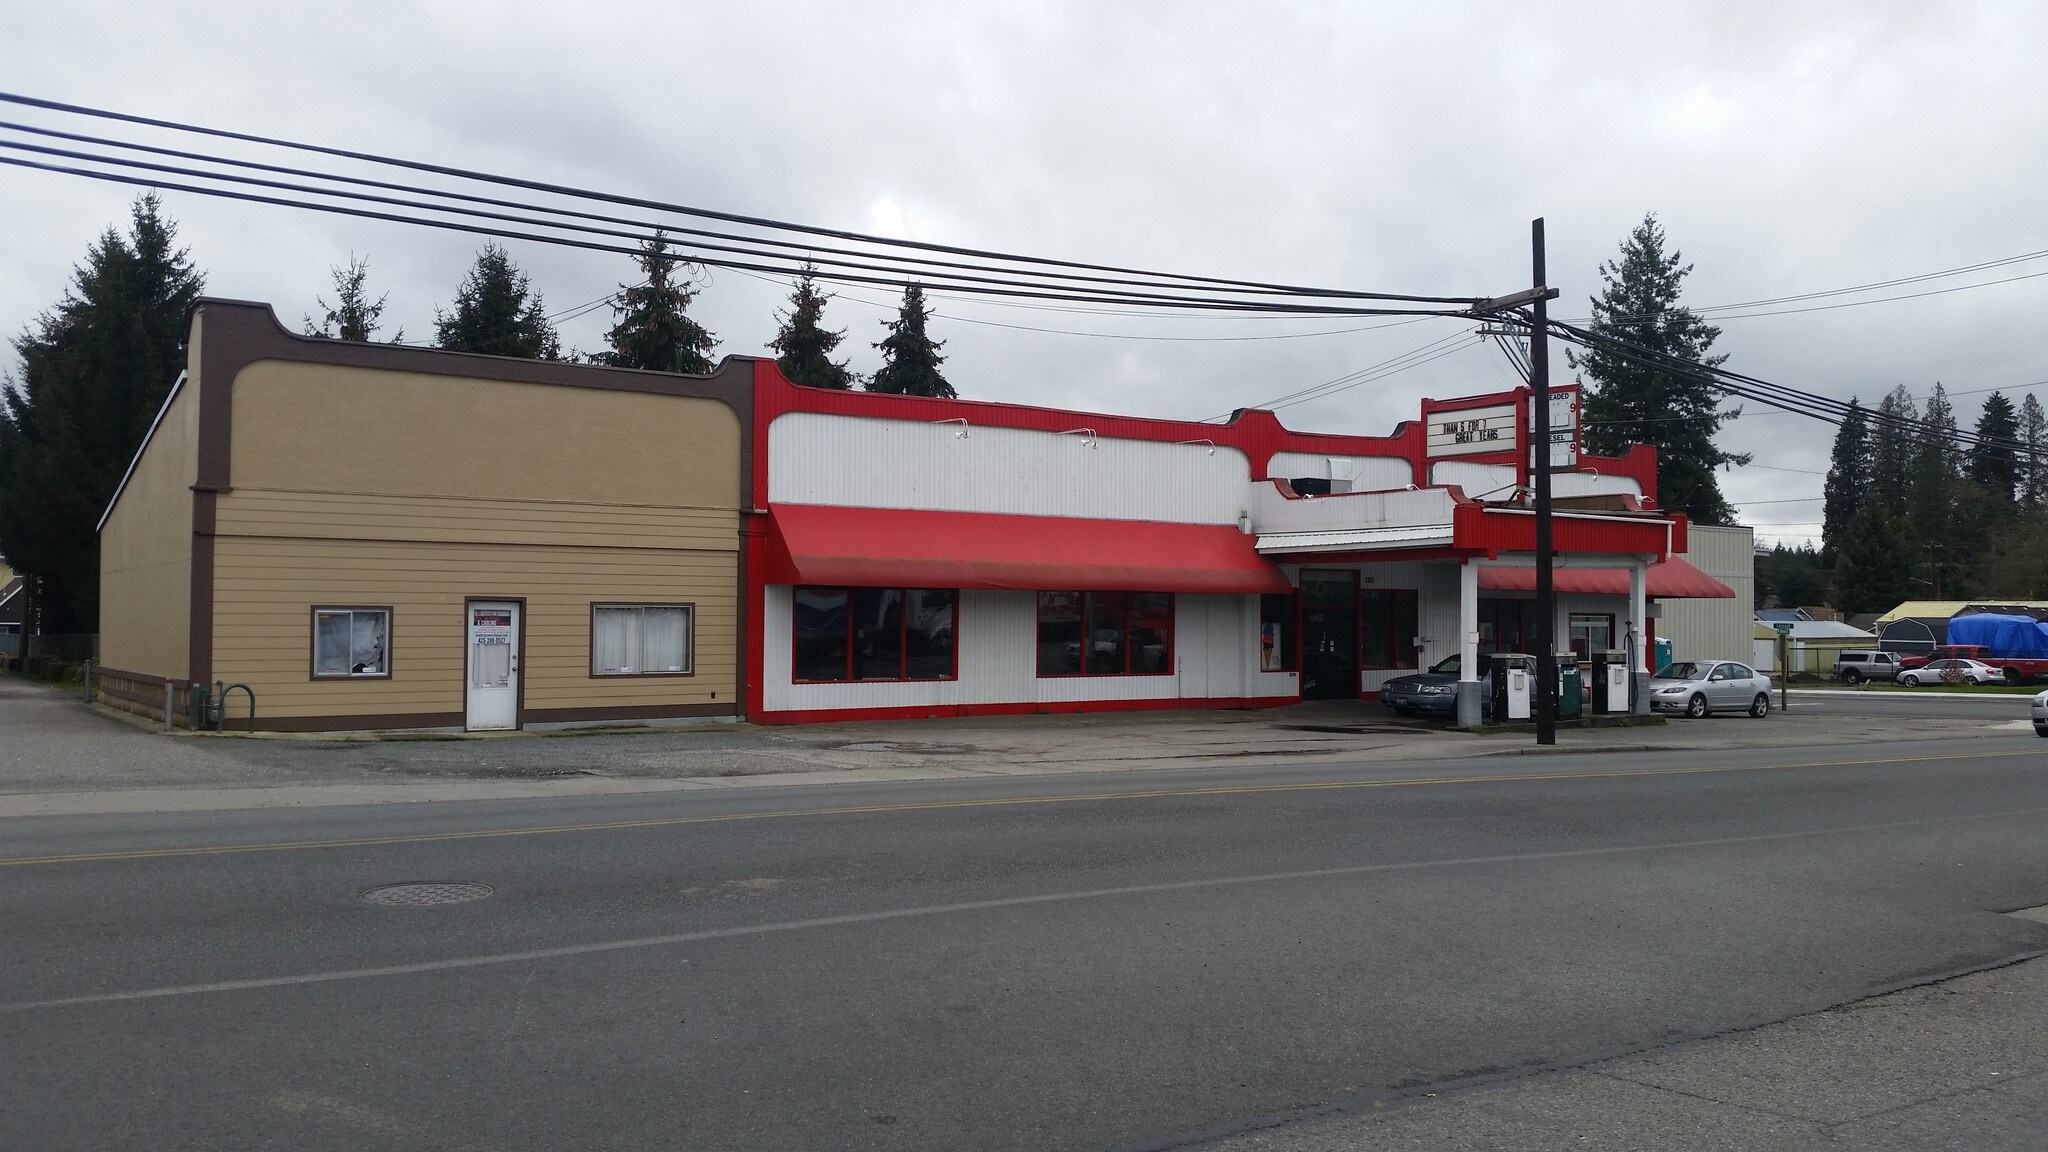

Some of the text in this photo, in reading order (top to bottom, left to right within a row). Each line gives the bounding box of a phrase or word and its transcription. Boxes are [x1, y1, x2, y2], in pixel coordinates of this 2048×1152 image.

[1570, 403, 1576, 413] 9
[1468, 419, 1479, 431] FOR
[1455, 429, 1498, 443] GREAT YEARS
[1570, 443, 1576, 453] 9
